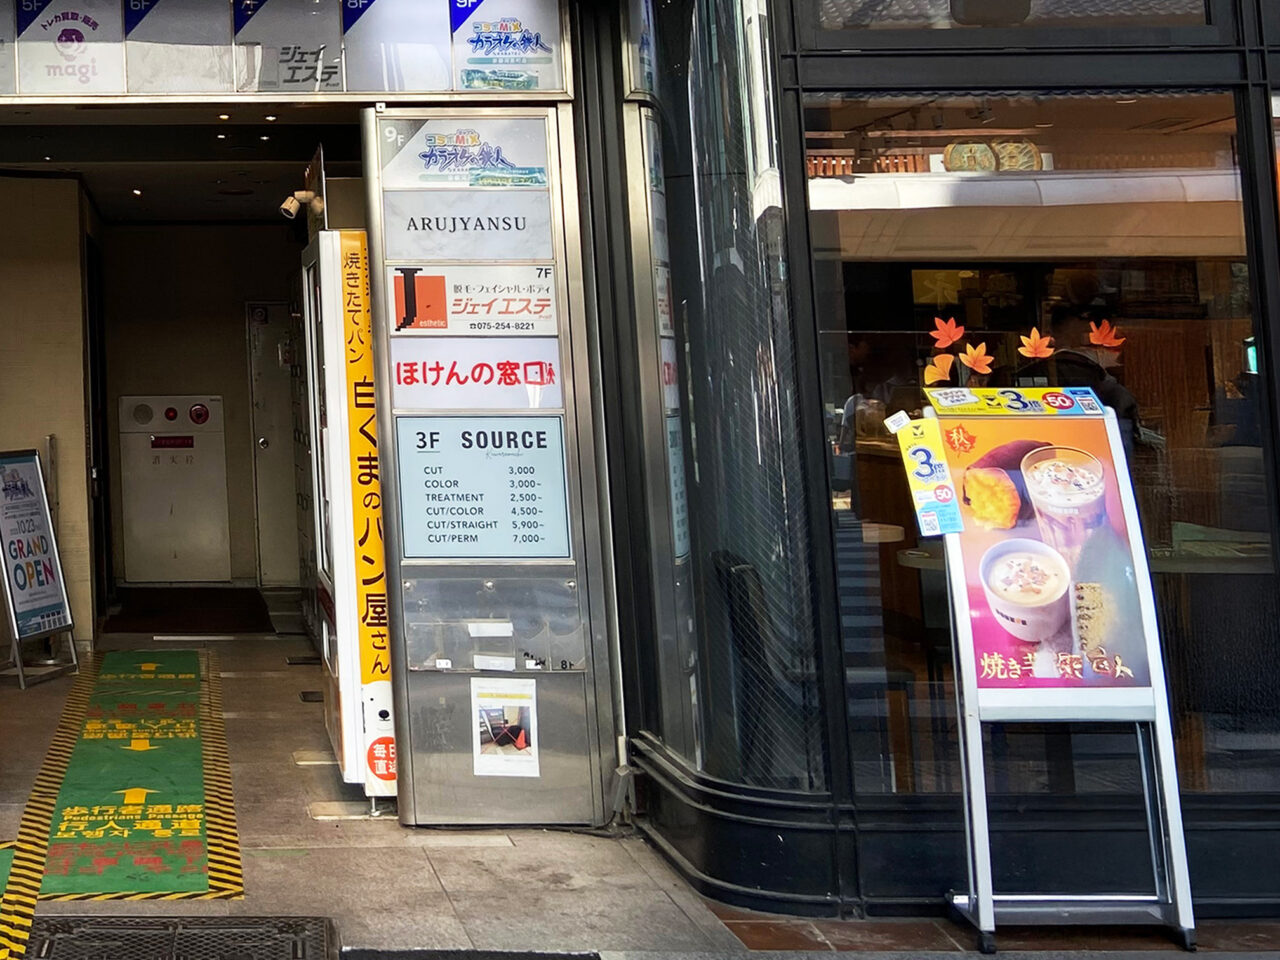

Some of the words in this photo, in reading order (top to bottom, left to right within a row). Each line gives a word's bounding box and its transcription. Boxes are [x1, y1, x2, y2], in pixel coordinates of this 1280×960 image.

[279, 44, 326, 63] ジェイ
[45, 57, 98, 84] magi
[283, 66, 338, 83] エステ
[384, 126, 404, 146] 9F
[407, 216, 527, 233] ARUJYANSU
[536, 268, 552, 278] 7F
[344, 253, 364, 364] 焼きたてパン
[451, 298, 551, 314] ジェイエステ
[419, 320, 447, 328] esthetic
[477, 322, 535, 330] 075-254-8221
[396, 360, 546, 386] ほけんの窓口
[416, 431, 440, 449] 3F
[461, 431, 547, 449] SOURCE
[424, 466, 443, 475] CUT
[508, 466, 535, 475] 3,000
[424, 480, 459, 488] COLOR
[425, 493, 484, 502] TREATMENT
[426, 507, 484, 516] CUT/COLOR
[427, 520, 498, 529] CUT/STRAIGHT
[428, 534, 478, 543] CUT/PERM
[8, 535, 48, 561] GRAND
[13, 557, 56, 591] OPEN
[62, 804, 204, 816] 歩行者通路
[58, 819, 202, 831] 行人通道
